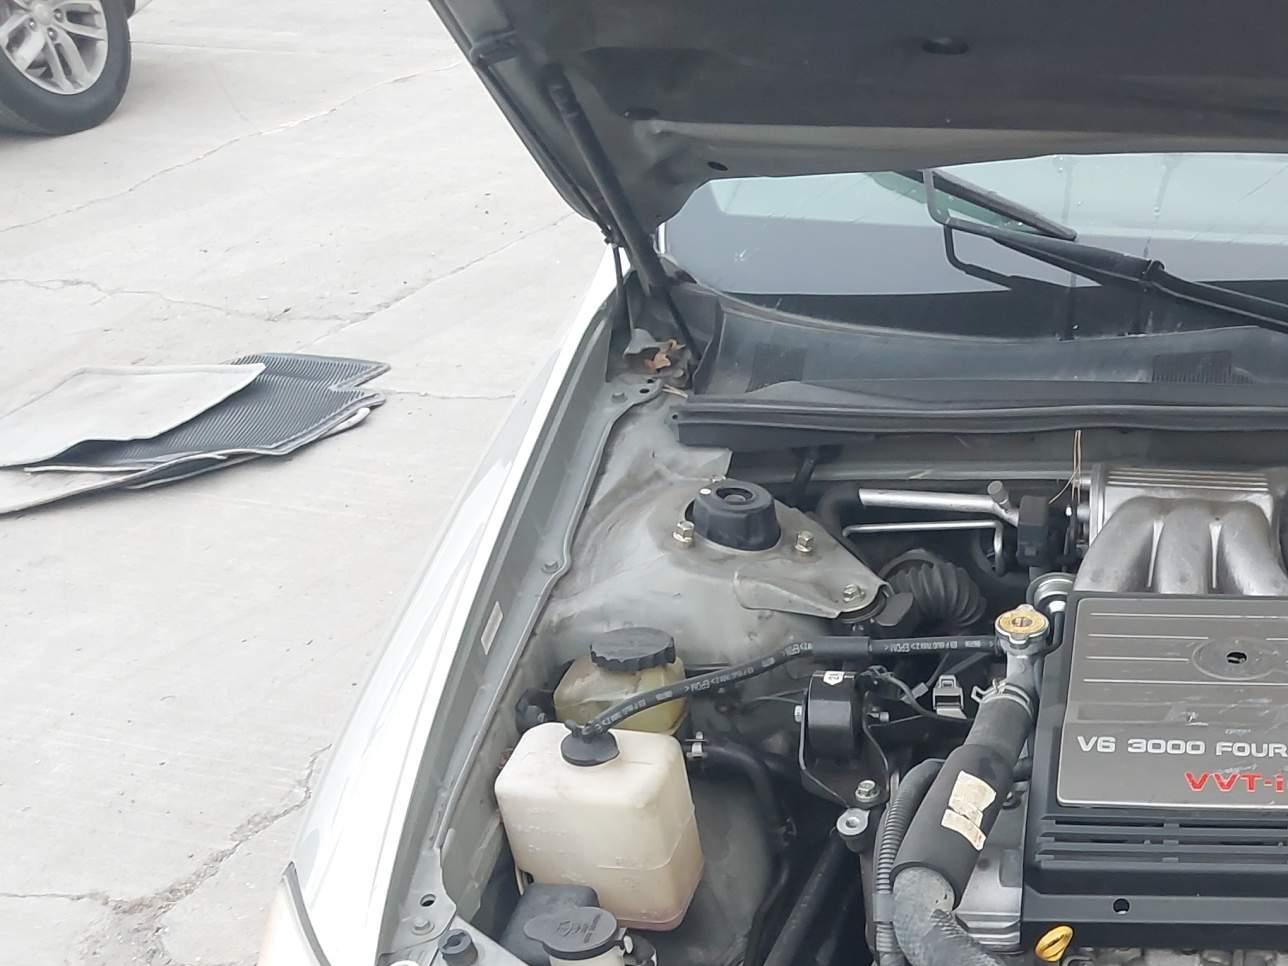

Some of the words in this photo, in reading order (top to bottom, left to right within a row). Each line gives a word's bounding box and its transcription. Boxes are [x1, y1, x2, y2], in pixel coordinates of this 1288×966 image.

[1077, 736, 1116, 753] V6
[1127, 738, 1206, 755] 3000
[1215, 741, 1288, 758] FOUR
[1184, 771, 1287, 793] VVT-i
